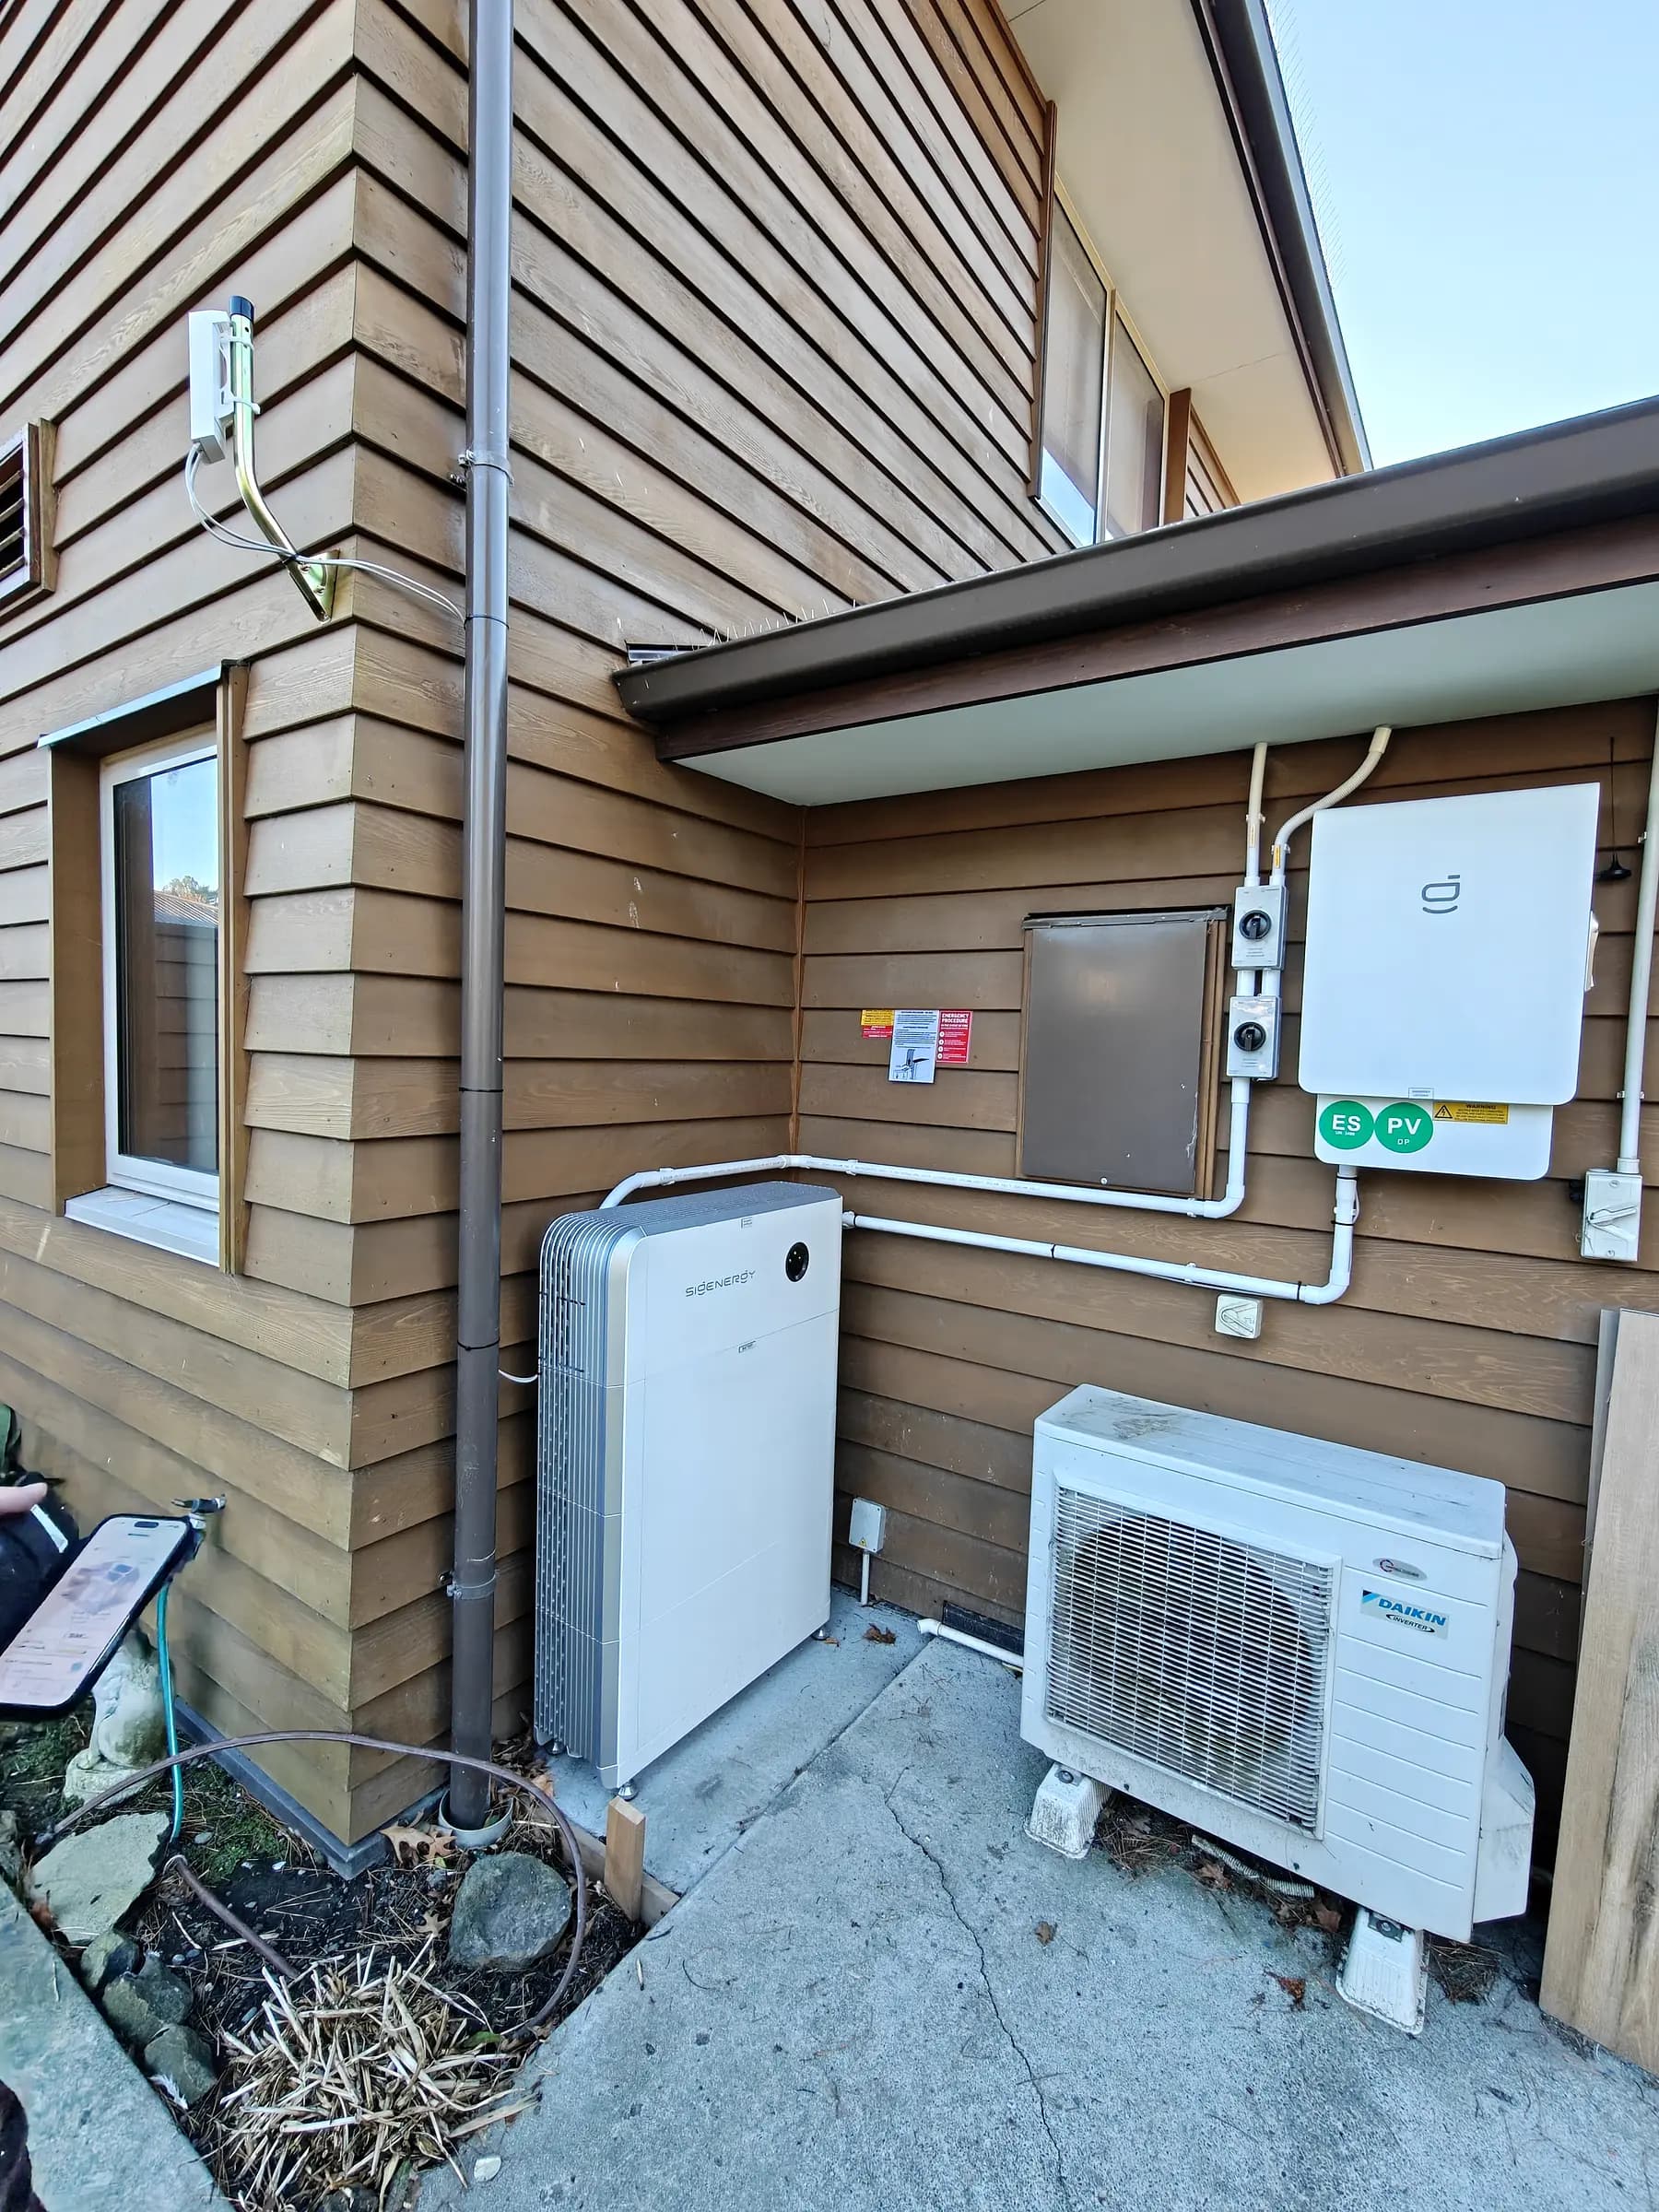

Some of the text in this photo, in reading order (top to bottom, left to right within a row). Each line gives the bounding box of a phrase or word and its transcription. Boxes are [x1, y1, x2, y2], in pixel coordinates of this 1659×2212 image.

[1332, 1114, 1361, 1132] ES
[1387, 1117, 1422, 1135] PV
[685, 1270, 756, 1297] SIGENERGY
[1378, 1598, 1446, 1627] DAIKIN
[1393, 1616, 1428, 1630] INVERTER
